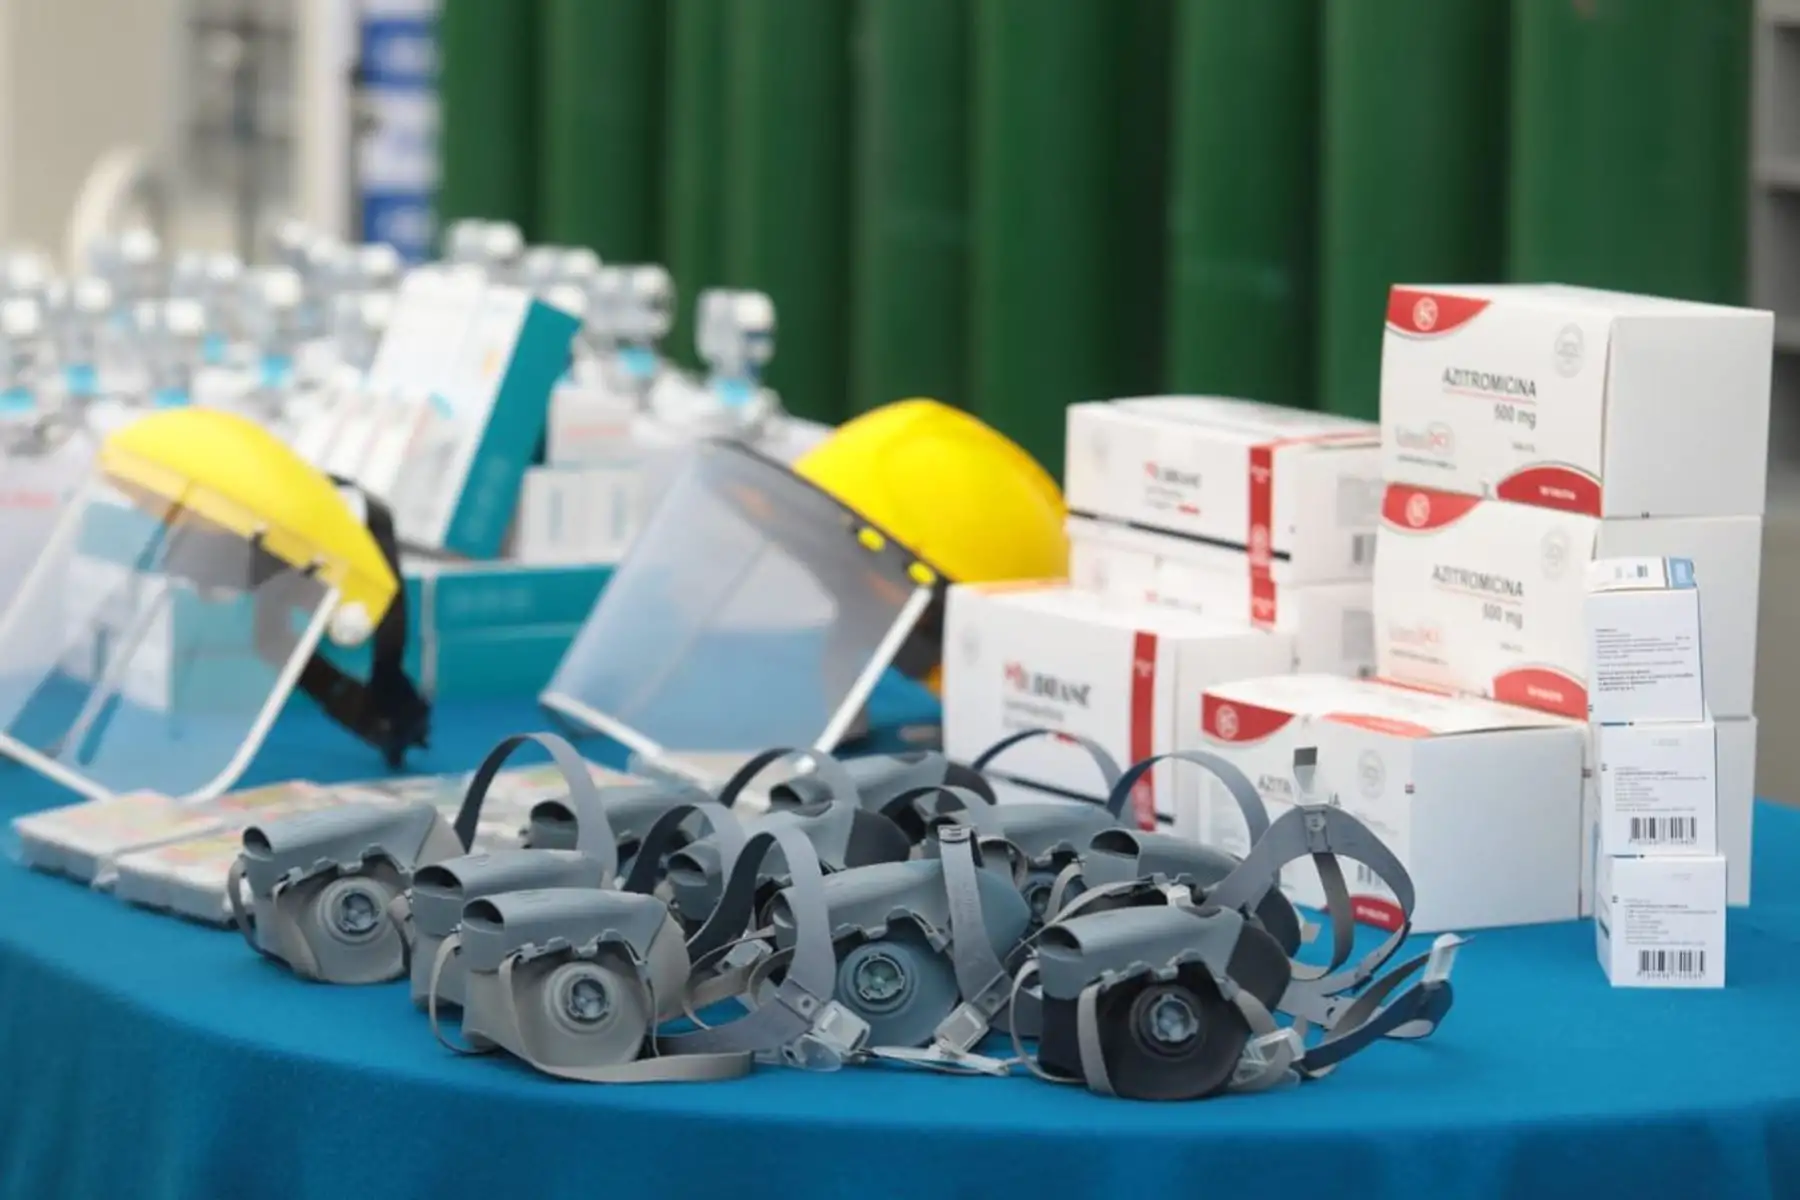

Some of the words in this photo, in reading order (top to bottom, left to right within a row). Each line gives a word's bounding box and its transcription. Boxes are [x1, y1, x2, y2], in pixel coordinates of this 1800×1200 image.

[1442, 366, 1537, 398] AZITROMICINA
[1494, 402, 1514, 423] 500
[1517, 409, 1537, 431] mg
[1432, 563, 1525, 597] AZITROMICINA
[1504, 609, 1523, 631] mg
